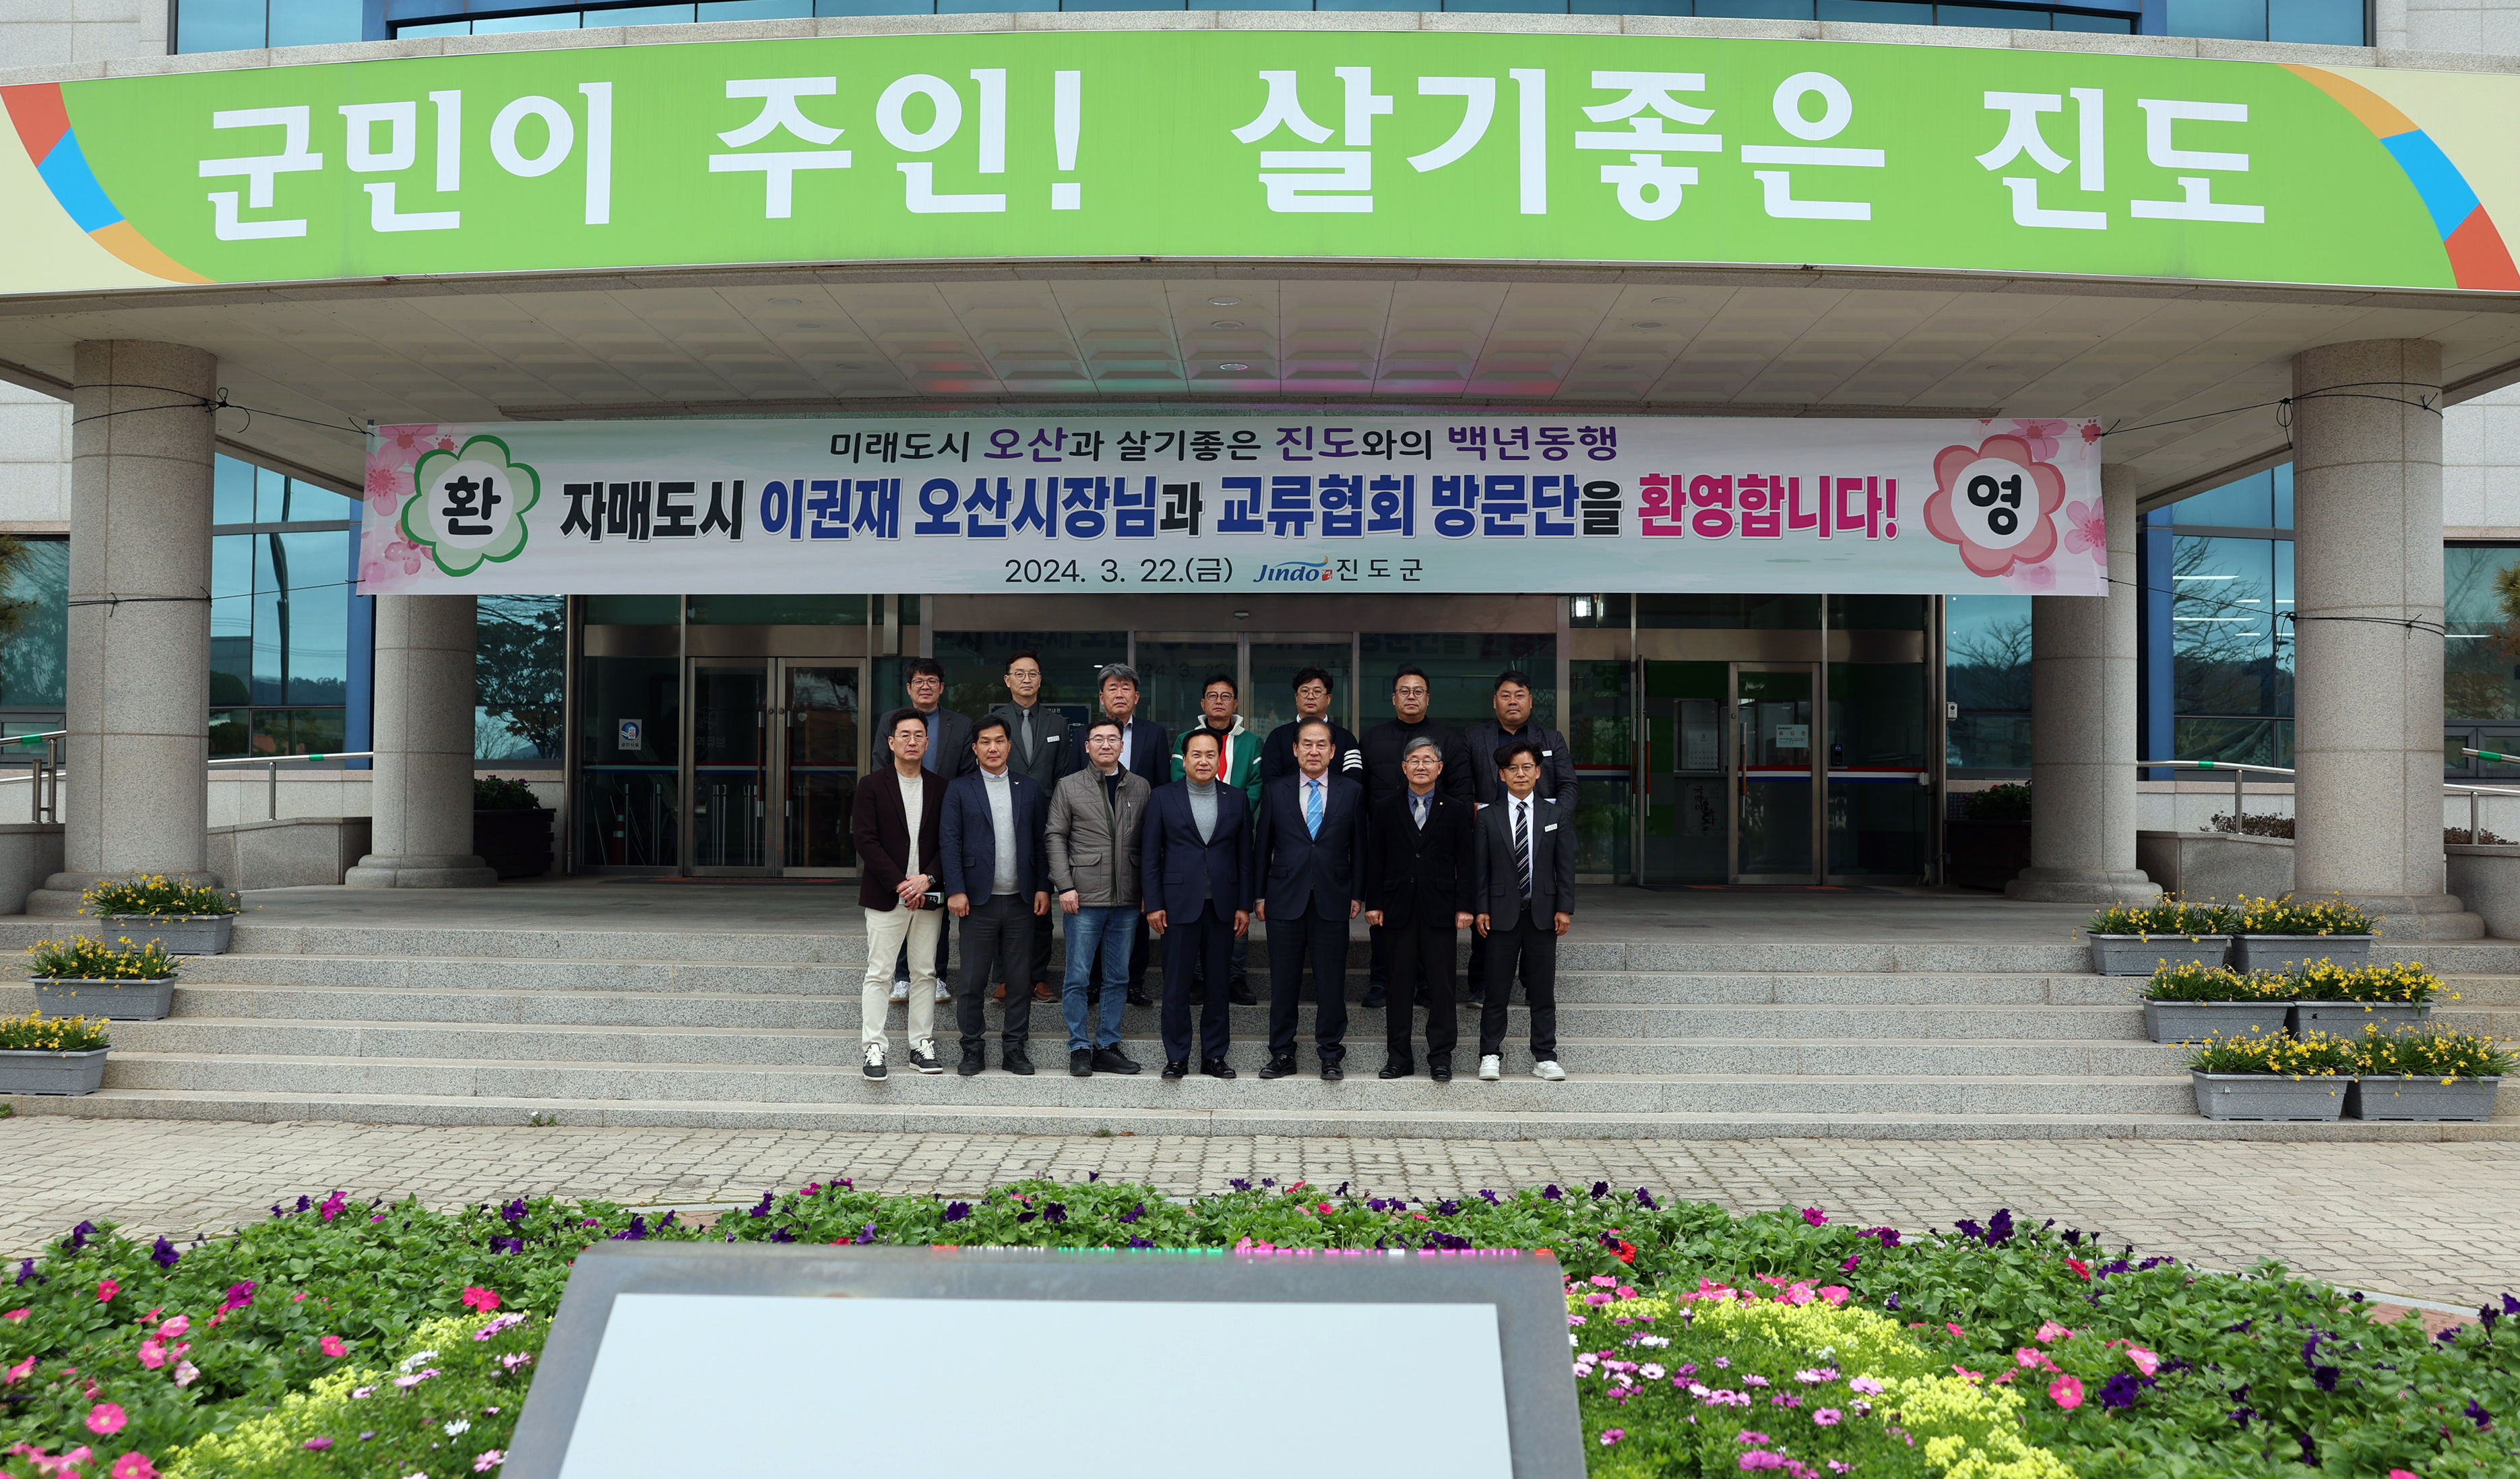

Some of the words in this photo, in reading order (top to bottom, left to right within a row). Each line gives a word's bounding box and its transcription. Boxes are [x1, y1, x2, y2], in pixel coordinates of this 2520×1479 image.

[199, 82, 612, 241] 군민이
[710, 69, 1081, 219] 주인!
[1232, 66, 1885, 221] 살기좋은
[1974, 87, 2265, 230] 진도
[830, 431, 970, 464] 미래도시
[984, 427, 1106, 463] 오산과
[1116, 429, 1263, 462] 살기좋은
[1275, 426, 1432, 462] 진도와의
[1448, 426, 1618, 462] 백년동행
[441, 475, 502, 536] 환
[560, 480, 746, 541] 자매도시
[760, 478, 902, 540] 이권재
[914, 476, 1203, 538] 오산시장님과
[1217, 474, 1416, 538] 교류협회
[1431, 473, 1623, 538] 방문단을
[1638, 473, 1898, 540] 환영합니다!
[1967, 474, 2023, 536] 영
[1005, 559, 1087, 584] 2024.
[1102, 559, 1126, 584] 3.
[1141, 558, 1233, 584] 22.(금)
